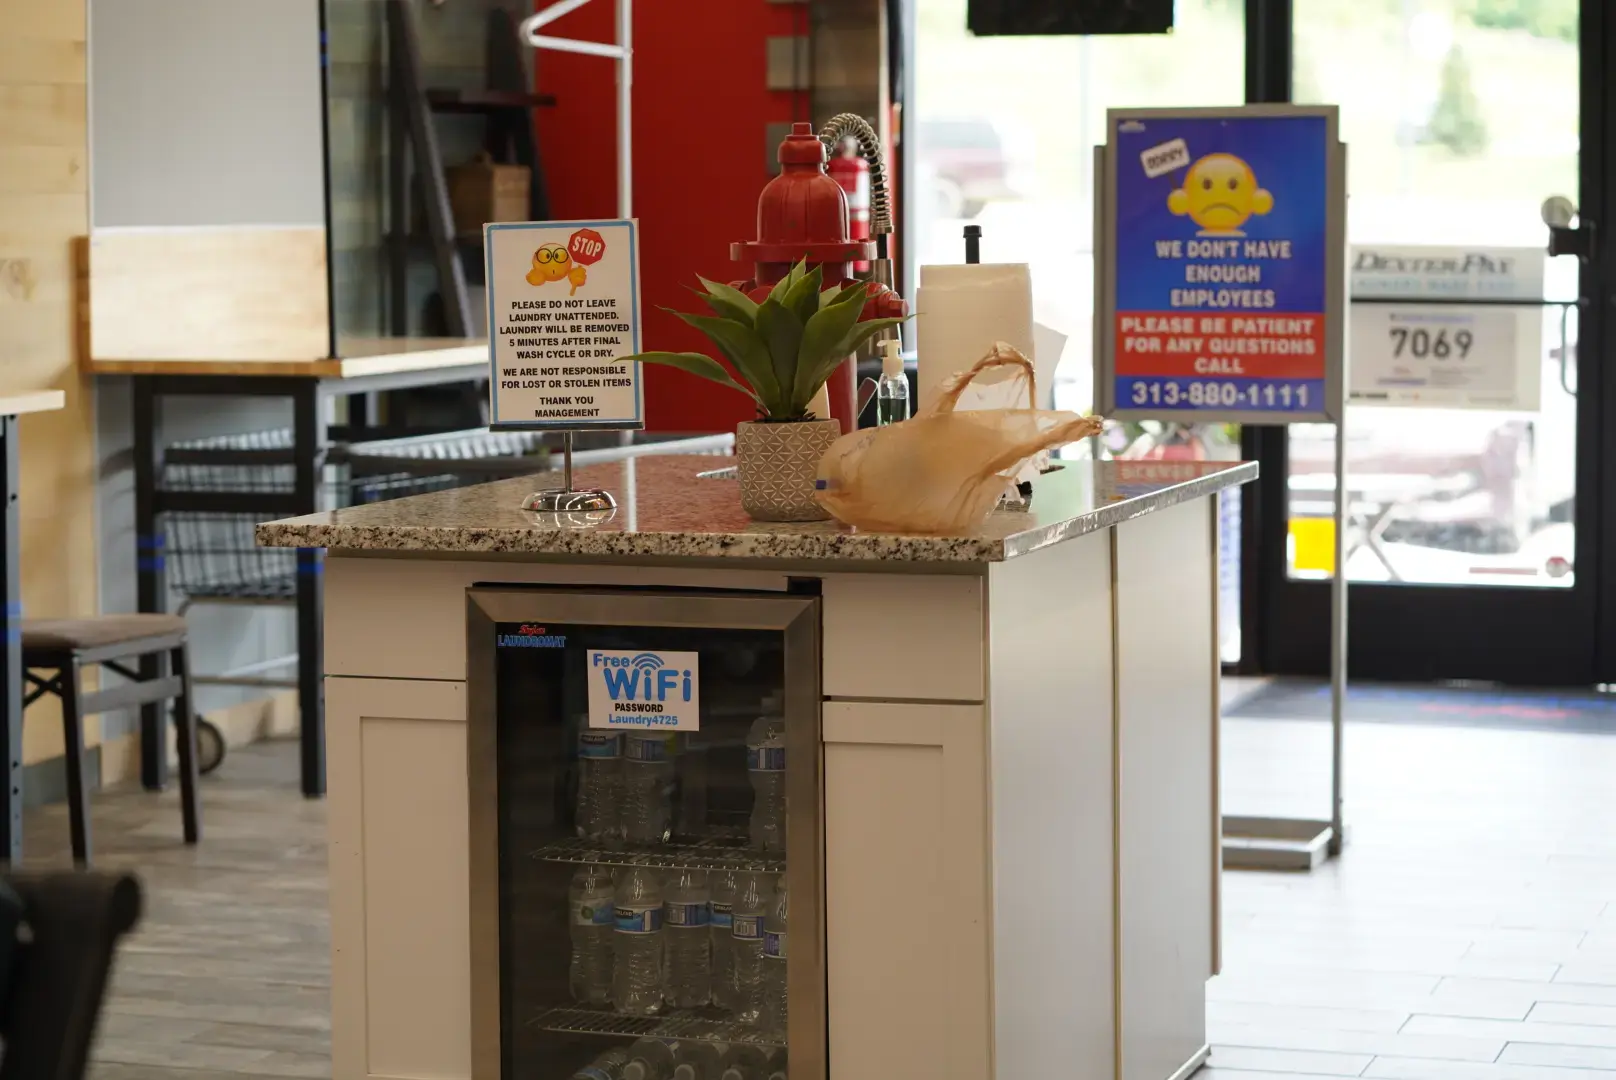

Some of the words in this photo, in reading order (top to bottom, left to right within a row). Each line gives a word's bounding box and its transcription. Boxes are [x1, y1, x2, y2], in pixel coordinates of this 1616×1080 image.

[572, 235, 602, 257] STOP
[1155, 240, 1182, 258] WE
[1187, 240, 1238, 258] DON'T
[1244, 240, 1291, 259] HAVE
[1185, 265, 1260, 283] ENOUGH
[512, 301, 547, 310] PLEASE
[549, 300, 562, 309] DO
[565, 300, 584, 308] NOT
[586, 299, 616, 308] LEAVE
[1170, 289, 1275, 308] EMPLOYEES
[509, 313, 552, 322] LAUNDRY
[555, 312, 619, 321] UNATTENDED.
[500, 326, 542, 335] LAUNDRY
[545, 325, 568, 334] WILL
[570, 325, 582, 333] BE
[585, 324, 629, 333] REMOVED
[1121, 317, 1194, 334] PLEASE
[1200, 318, 1226, 334] BE
[1232, 318, 1314, 335] PATIENT
[509, 339, 515, 347] 5
[517, 338, 559, 347] MINUTES
[561, 337, 591, 346] AFTER
[594, 336, 620, 345] FINAL
[1124, 336, 1161, 353] FOR
[1166, 337, 1203, 353] ANY
[1209, 338, 1315, 355] QUESTIONS
[1389, 328, 1473, 360] 7069
[516, 351, 544, 359] WASH
[546, 350, 576, 359] CYCLE
[578, 350, 592, 358] OR
[594, 349, 614, 358] DRY.
[503, 368, 517, 376] WE
[520, 368, 538, 376] ARE
[541, 367, 560, 376] NOT
[562, 366, 626, 375] RESPONSIBLE
[1194, 357, 1244, 374] CALL
[501, 381, 520, 389] FOR
[523, 380, 546, 388] LOST
[549, 380, 562, 388] OR
[565, 379, 600, 388] STOLEN
[603, 378, 631, 387] ITEMS
[540, 397, 572, 405] THANK
[574, 396, 594, 405] YOU
[1132, 381, 1308, 407] 313-880-1111
[535, 408, 599, 417] MANAGEMENT
[497, 635, 567, 648] LAUNDROMAT
[593, 653, 630, 667] Free
[603, 667, 691, 702] WiFi
[615, 703, 663, 713] PASSWORD
[609, 714, 678, 727] Laundry4725
